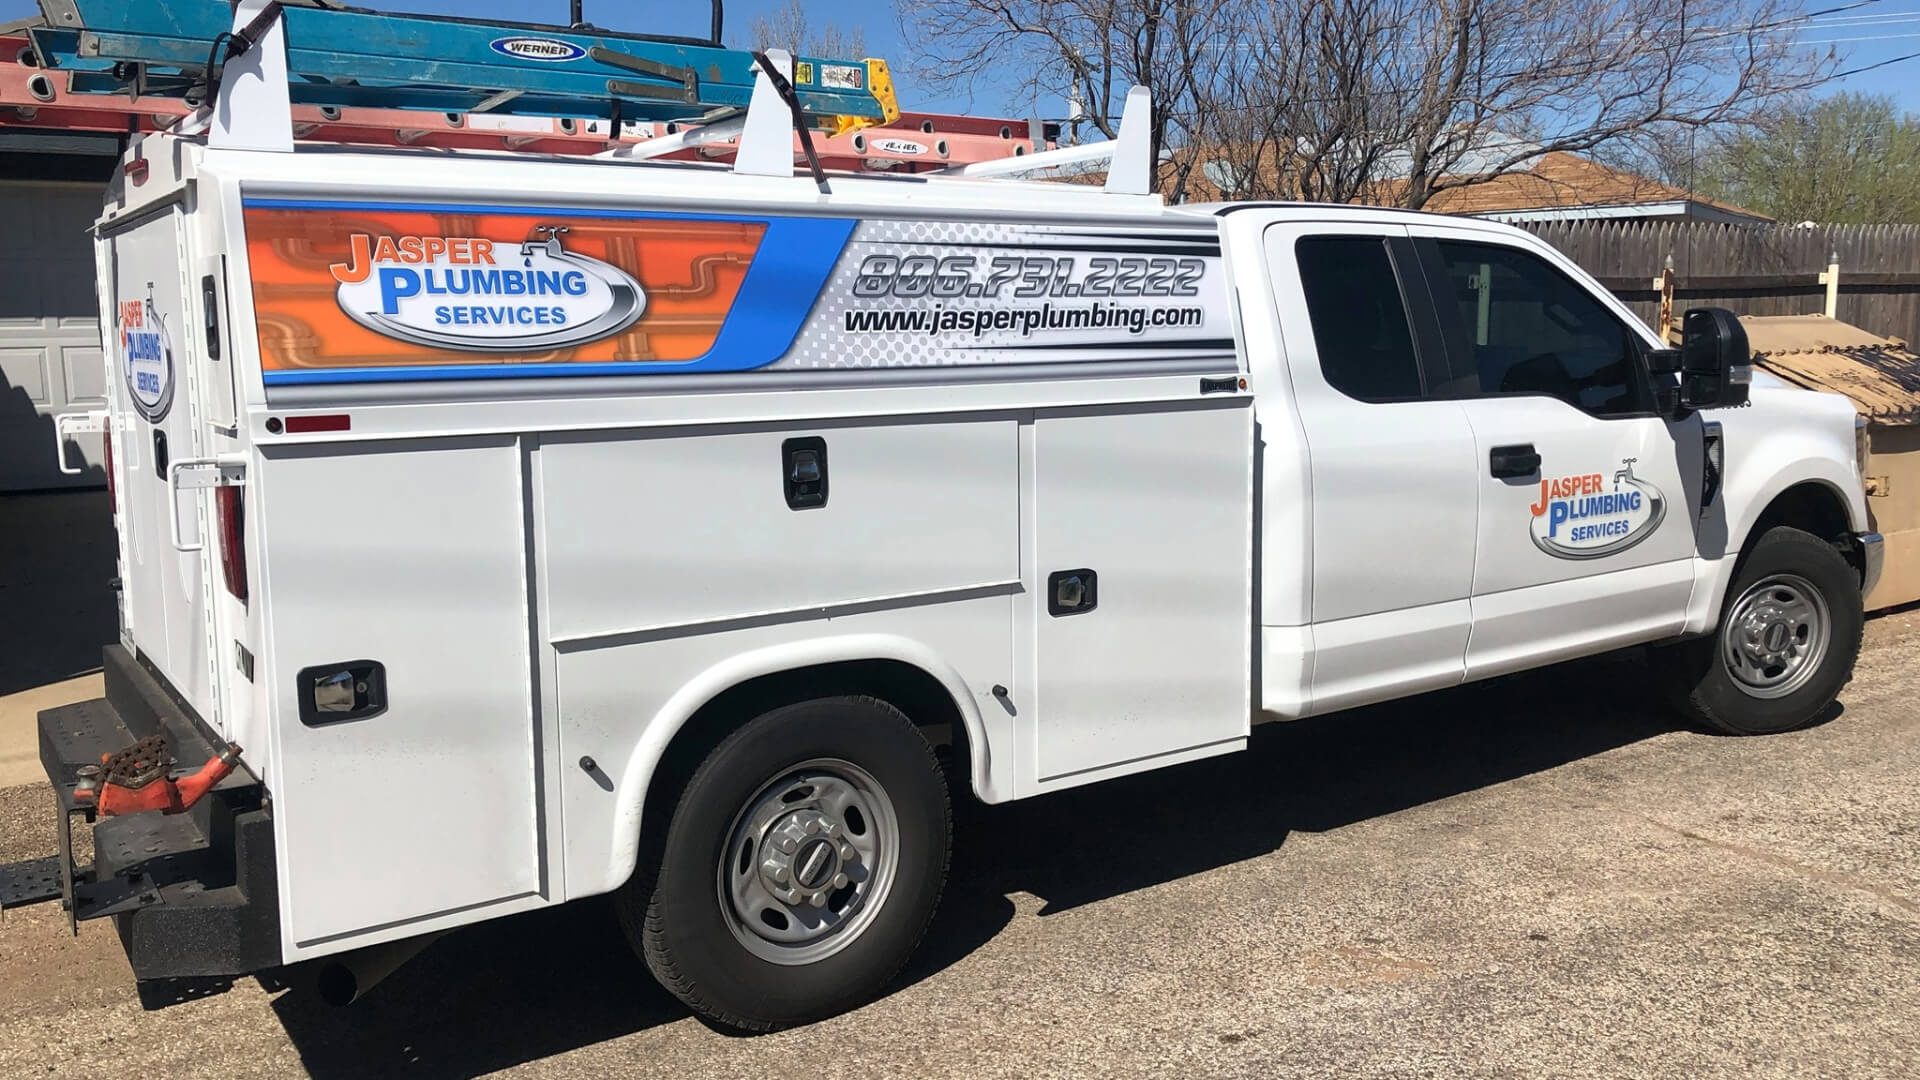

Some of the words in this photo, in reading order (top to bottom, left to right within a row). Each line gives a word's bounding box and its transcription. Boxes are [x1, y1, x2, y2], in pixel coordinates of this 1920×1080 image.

[511, 43, 568, 55] WERNER
[330, 234, 496, 283] JASPER
[853, 254, 1205, 298] 806.731.2222
[378, 268, 587, 314] PLUMBING
[435, 306, 567, 325] SERVICES
[845, 303, 1202, 335] www.jasperplumbing.com
[1530, 474, 1603, 517] JASPER
[1549, 491, 1641, 538] PLUMBING
[1571, 520, 1629, 541] SERVICES
